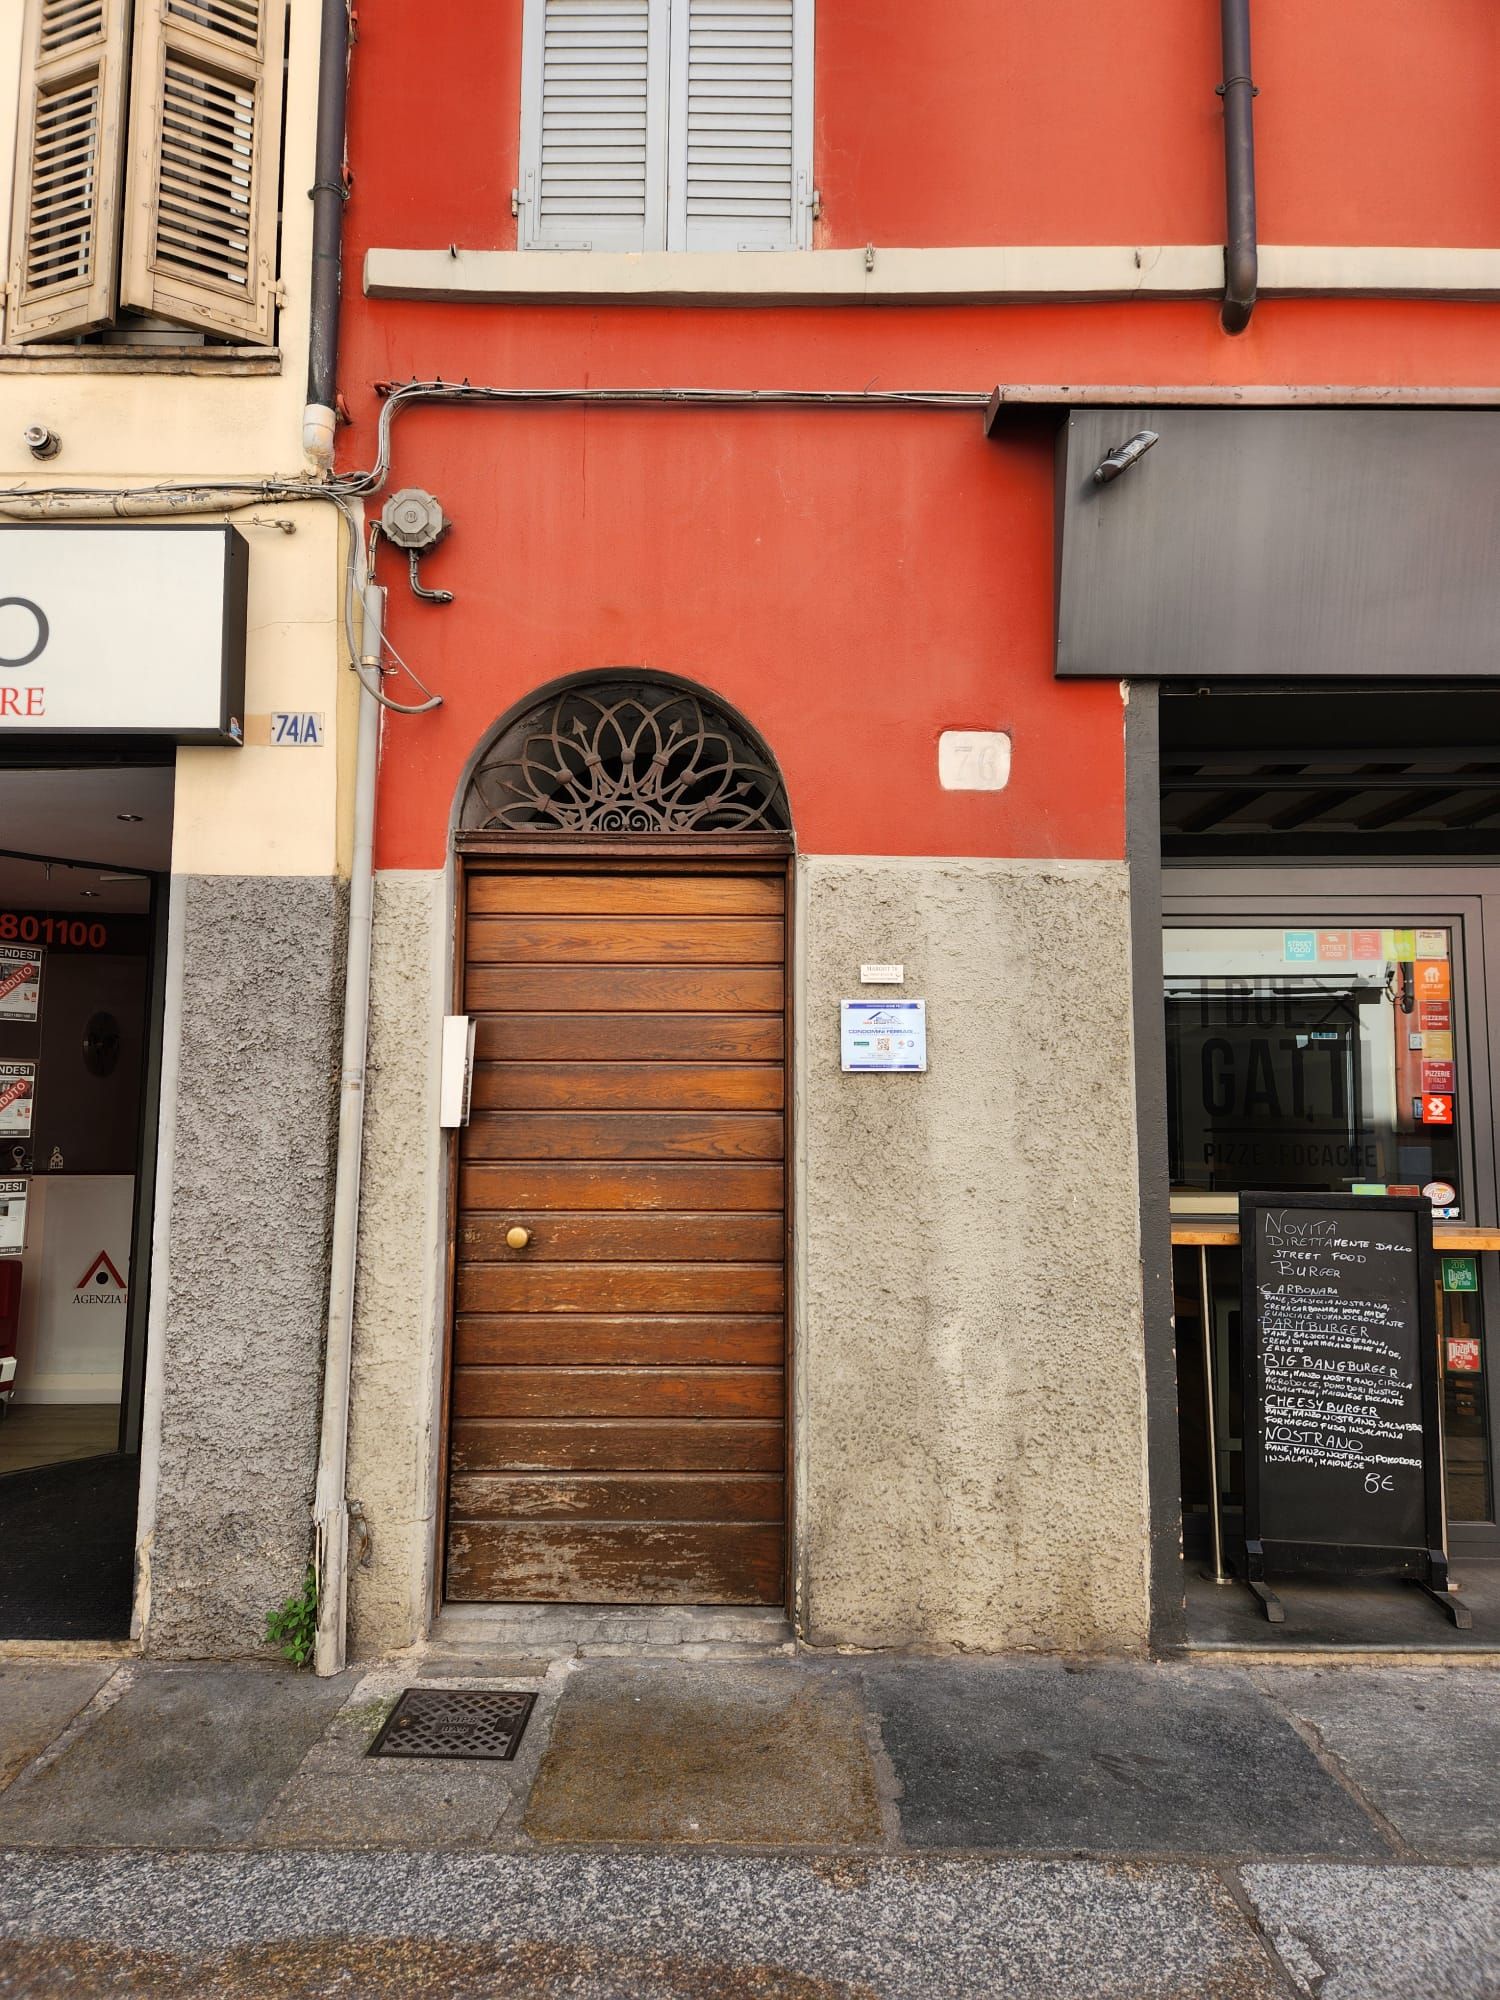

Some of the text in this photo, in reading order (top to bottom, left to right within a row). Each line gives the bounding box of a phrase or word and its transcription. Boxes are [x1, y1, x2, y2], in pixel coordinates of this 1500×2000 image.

[276, 713, 318, 744] 74/A
[1272, 1249, 1367, 1264] STREET FOOD
[72, 1294, 122, 1304] AGENZIA
[1263, 1353, 1298, 1368] BIG
[1265, 1425, 1364, 1451] NOSTRANO
[1319, 1457, 1365, 1469] MAIONESE
